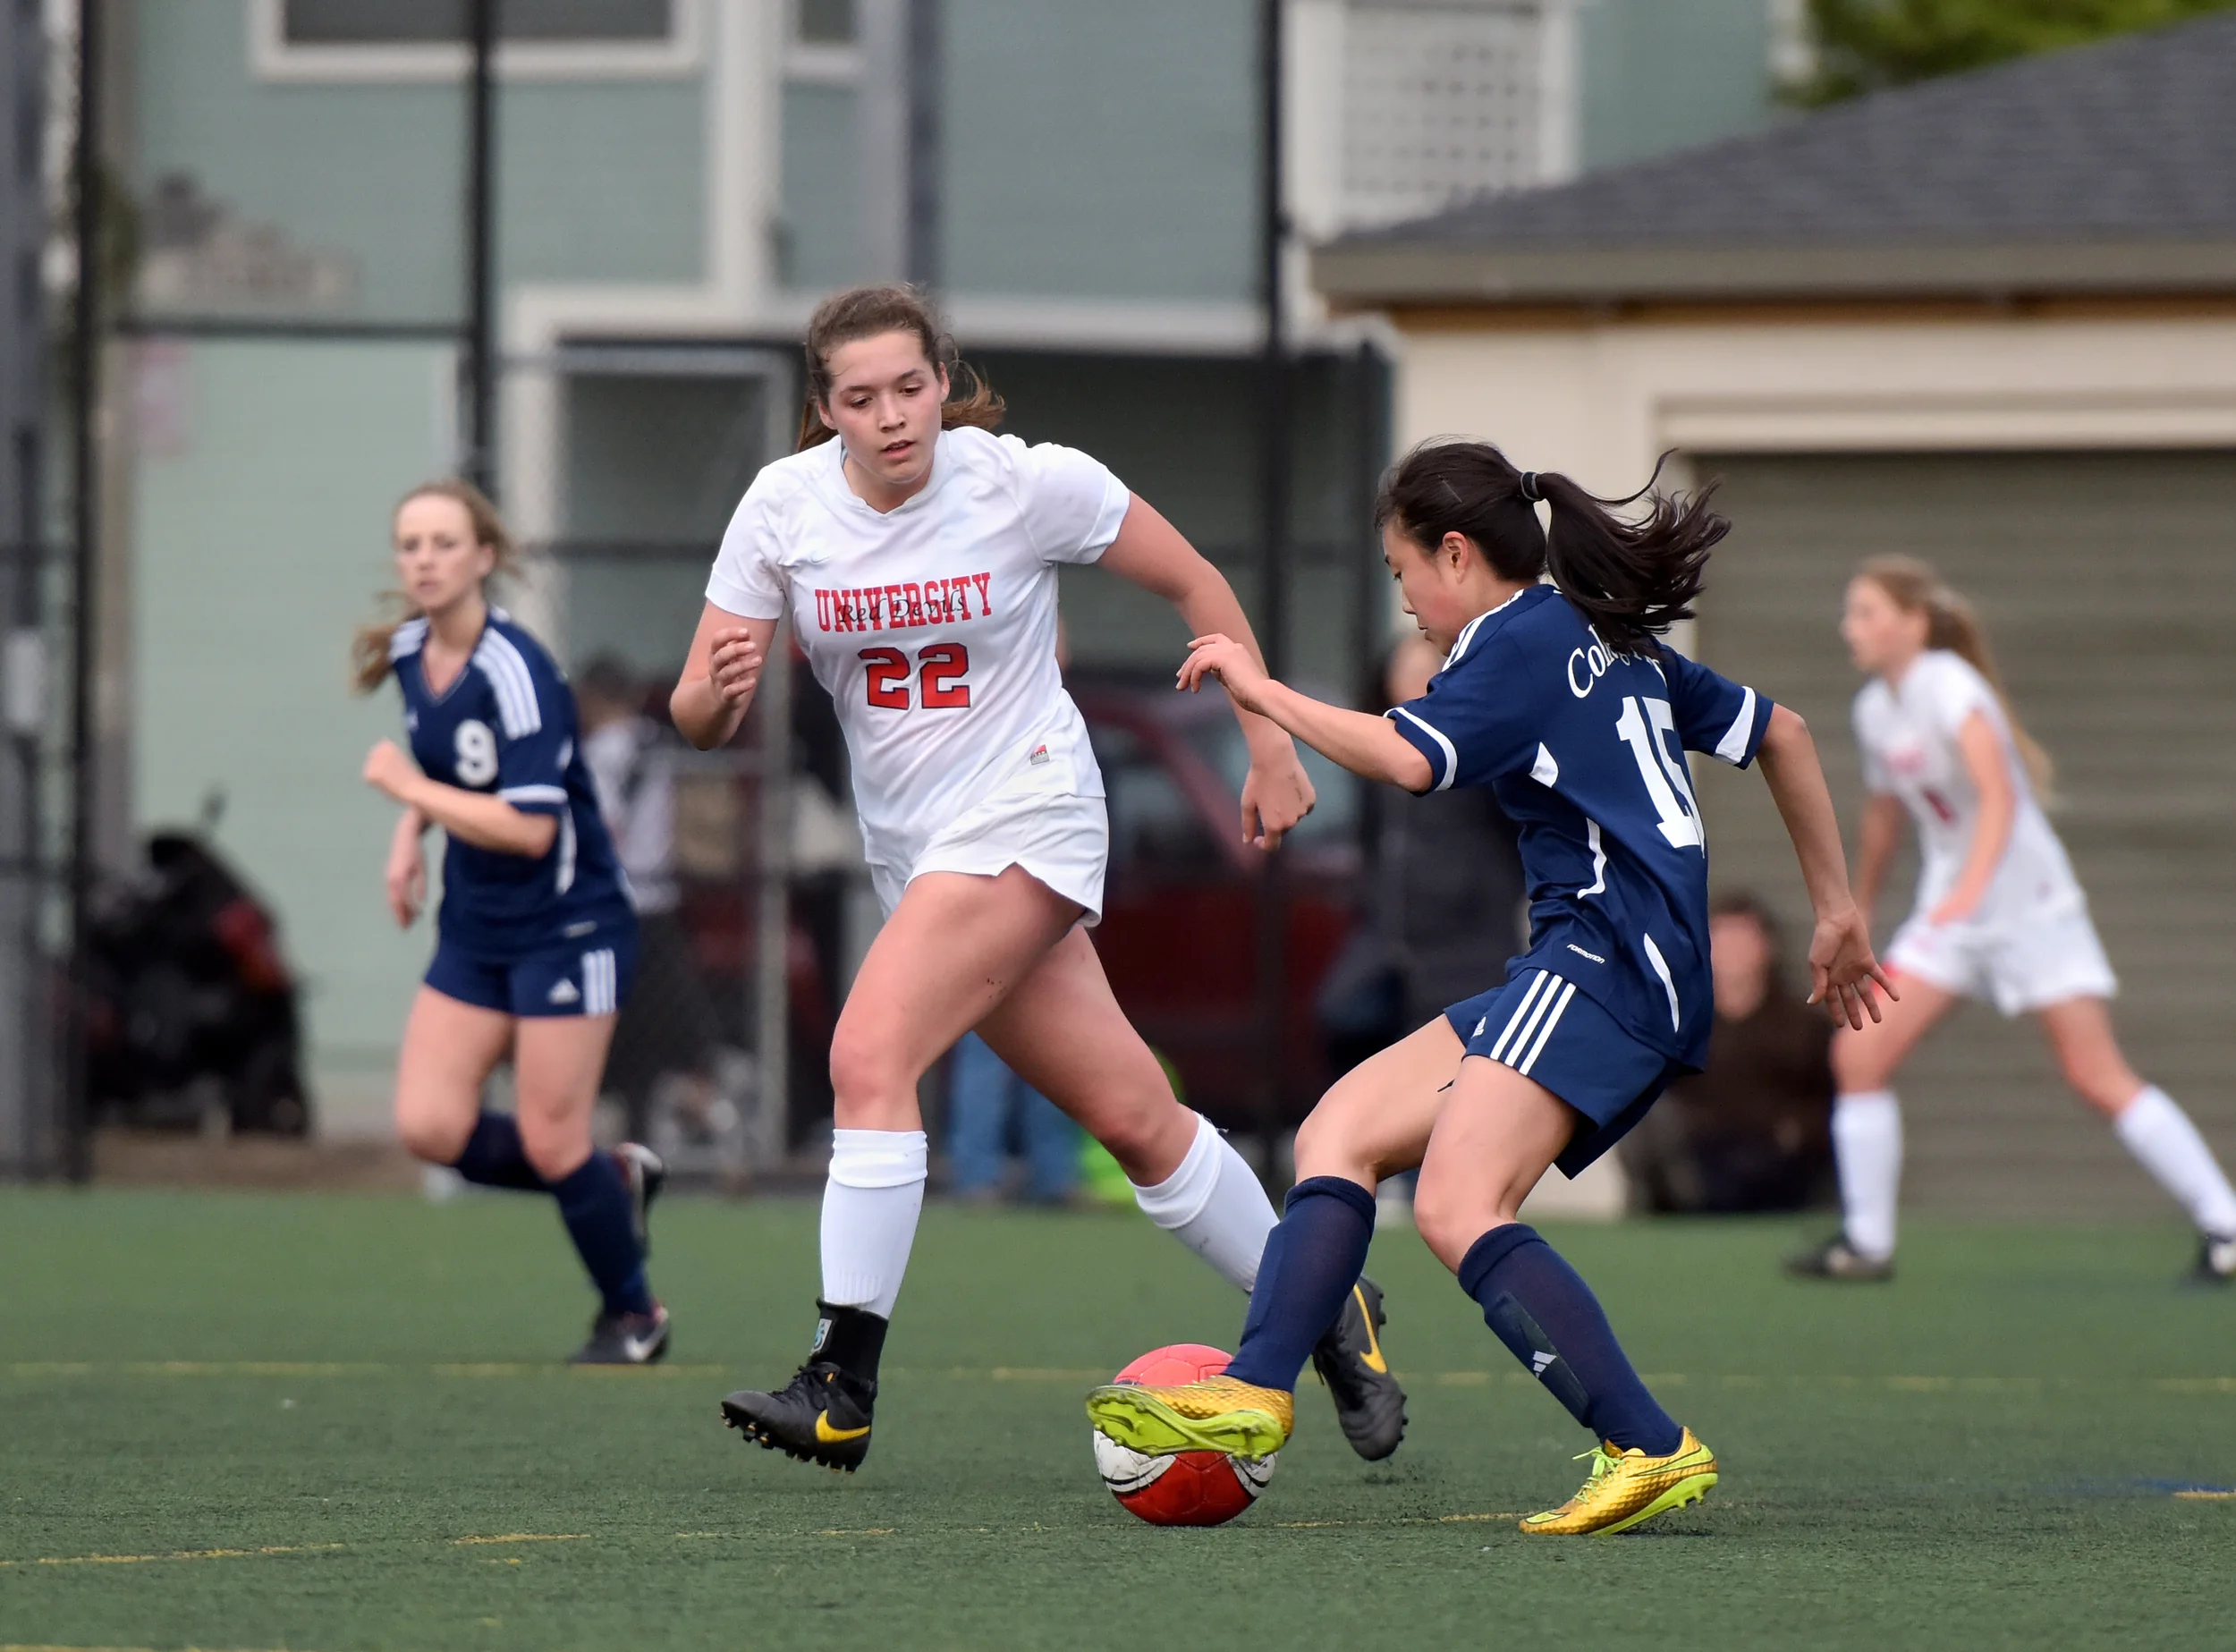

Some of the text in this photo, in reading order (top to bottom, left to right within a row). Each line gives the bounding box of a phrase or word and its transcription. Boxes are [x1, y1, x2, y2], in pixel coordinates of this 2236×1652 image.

[816, 572, 992, 632] UNIVERSITY
[838, 590, 964, 623] Red Devils
[857, 642, 970, 710] 22
[455, 719, 499, 786] 9
[1615, 695, 1706, 857] 15
